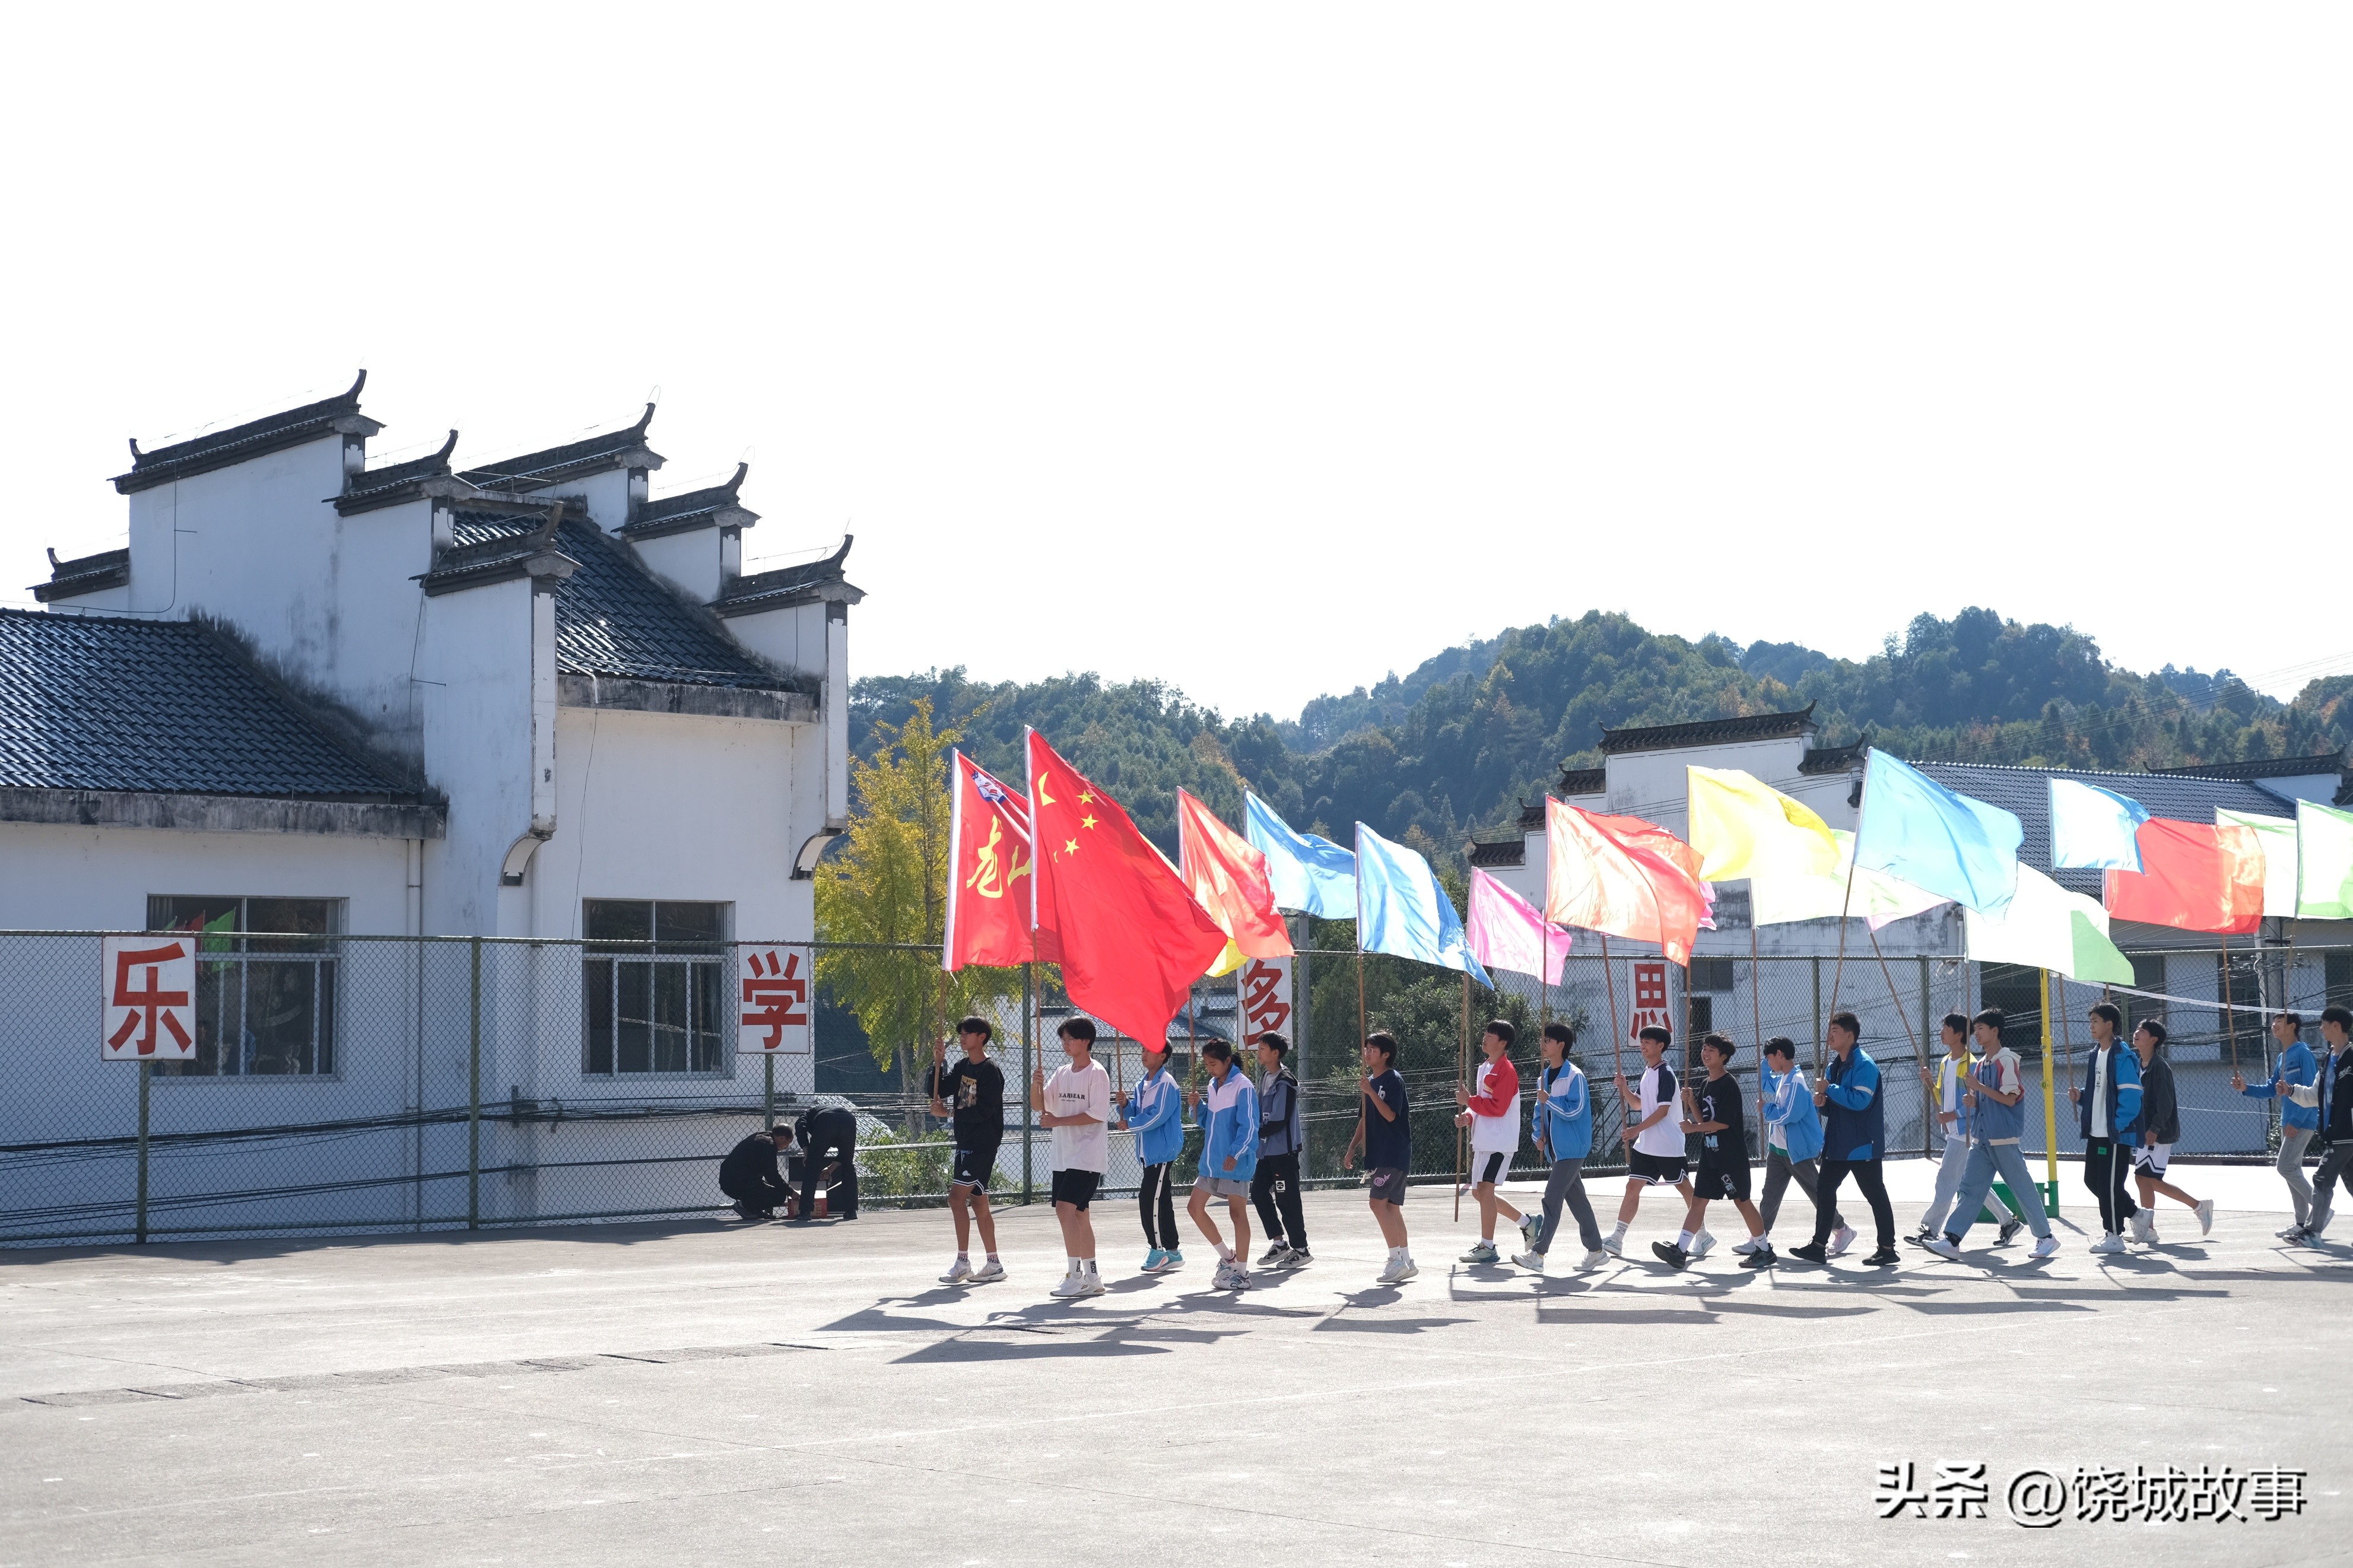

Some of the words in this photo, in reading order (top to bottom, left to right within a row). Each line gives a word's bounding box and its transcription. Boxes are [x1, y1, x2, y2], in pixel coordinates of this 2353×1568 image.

[107, 942, 192, 1055] 乐
[742, 950, 806, 1049] 学
[1241, 959, 1291, 1047] 多
[1630, 963, 1673, 1040] 思
